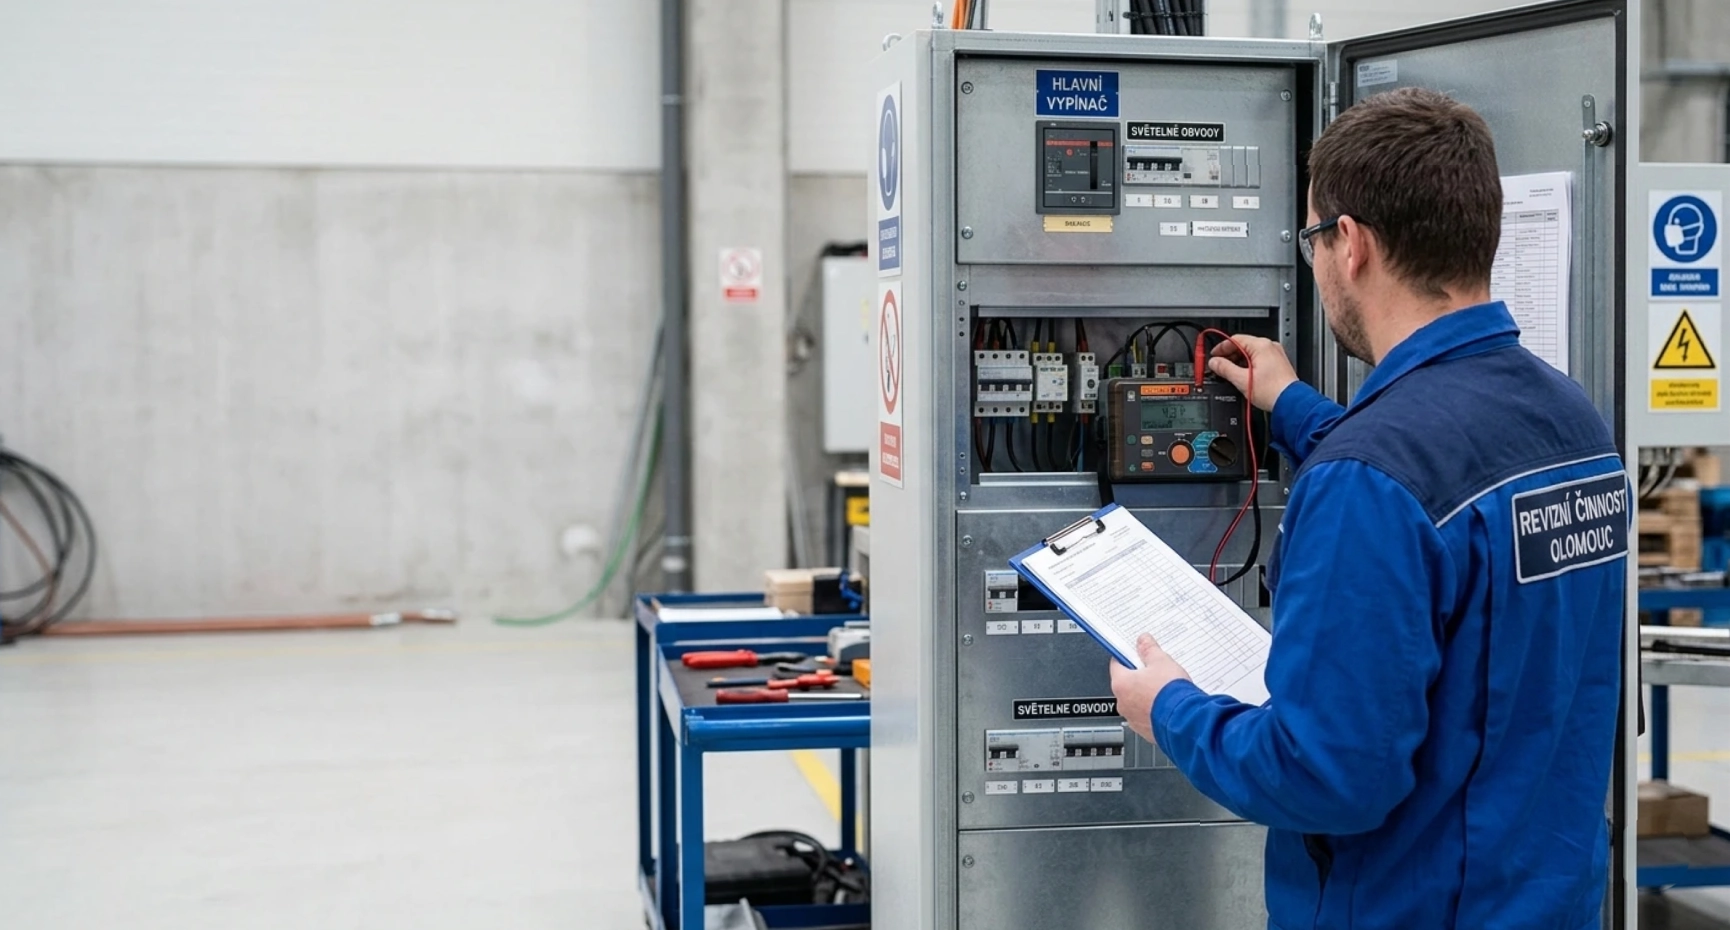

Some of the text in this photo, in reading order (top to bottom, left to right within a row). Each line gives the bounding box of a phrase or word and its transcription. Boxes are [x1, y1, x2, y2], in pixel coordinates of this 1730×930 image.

[1519, 490, 1625, 536] REVIZNÍ ČINNOST
[1550, 525, 1614, 563] OLOMOUC
[1072, 702, 1115, 714] OBVODY
